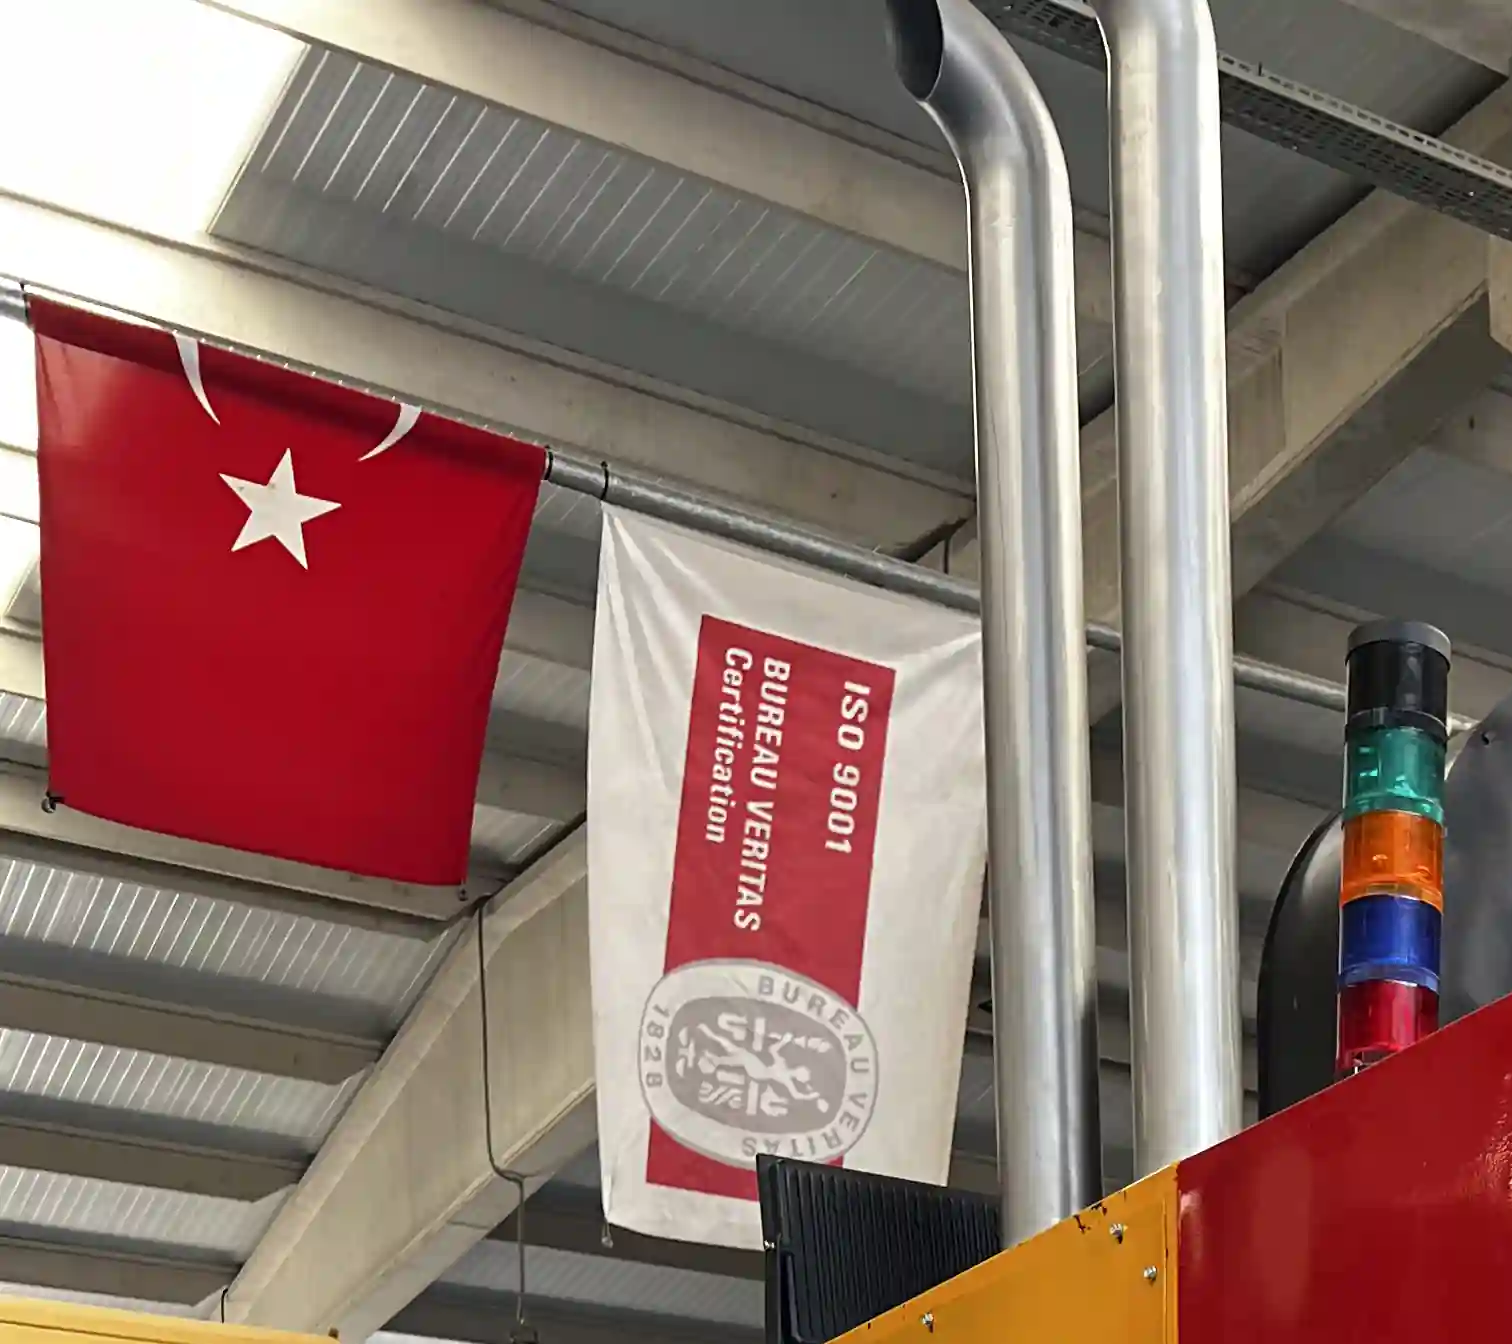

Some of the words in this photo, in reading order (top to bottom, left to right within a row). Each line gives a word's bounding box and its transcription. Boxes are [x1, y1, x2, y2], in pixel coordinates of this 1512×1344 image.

[705, 647, 753, 843] Certification
[749, 657, 791, 790] BUREAU
[837, 681, 871, 750] ISO
[825, 762, 860, 854] 9001
[733, 800, 774, 931] VERITAS
[645, 1003, 671, 1089] 1828
[757, 975, 870, 1075] BUREAU
[741, 1092, 869, 1158] VERITAS
